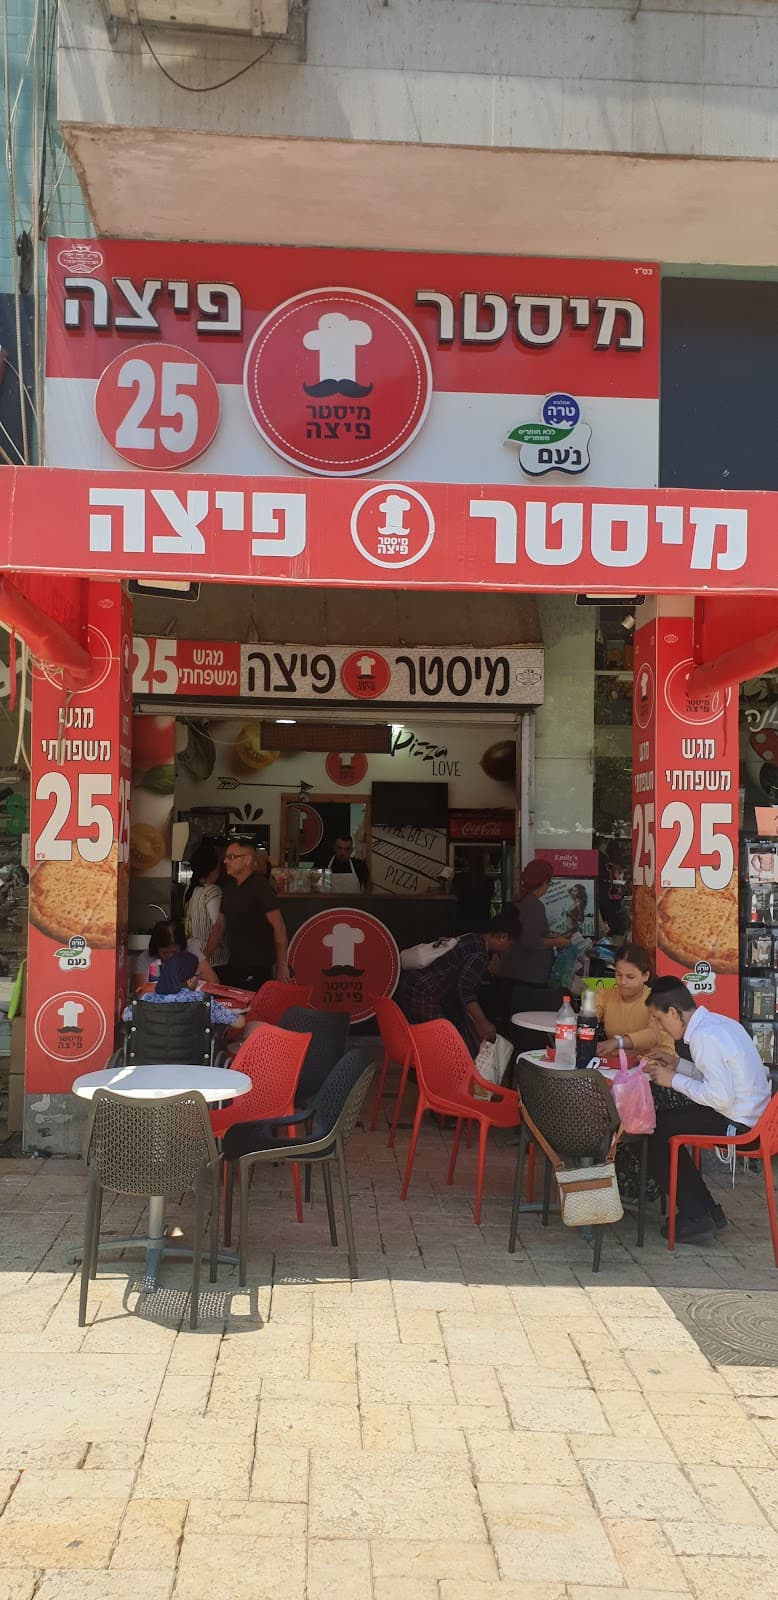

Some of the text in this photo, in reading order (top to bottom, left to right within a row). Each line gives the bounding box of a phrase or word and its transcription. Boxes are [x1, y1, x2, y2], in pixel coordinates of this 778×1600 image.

[64, 277, 644, 350] מיסטר פיצה
[115, 359, 198, 453] 25
[306, 405, 371, 420] מיסטר
[547, 406, 575, 416] טרה
[306, 422, 371, 439] פיצה
[89, 488, 748, 571] מיסטר פיצה
[378, 537, 408, 545] מיסטר
[378, 545, 408, 554] פיצה
[132, 637, 178, 694] 25
[193, 649, 223, 666] מגש
[179, 668, 237, 686] משפחתי
[248, 652, 336, 693] פיצה
[395, 656, 510, 696] מיסטר
[391, 730, 448, 761] Pizza
[681, 738, 715, 759] מגש
[432, 761, 462, 777] LOVE
[665, 770, 731, 791] משפחתי
[34, 771, 114, 863] 25
[407, 828, 438, 850] BEST
[633, 802, 655, 887] 25
[660, 801, 734, 890] 25
[384, 865, 417, 892] PIZZA
